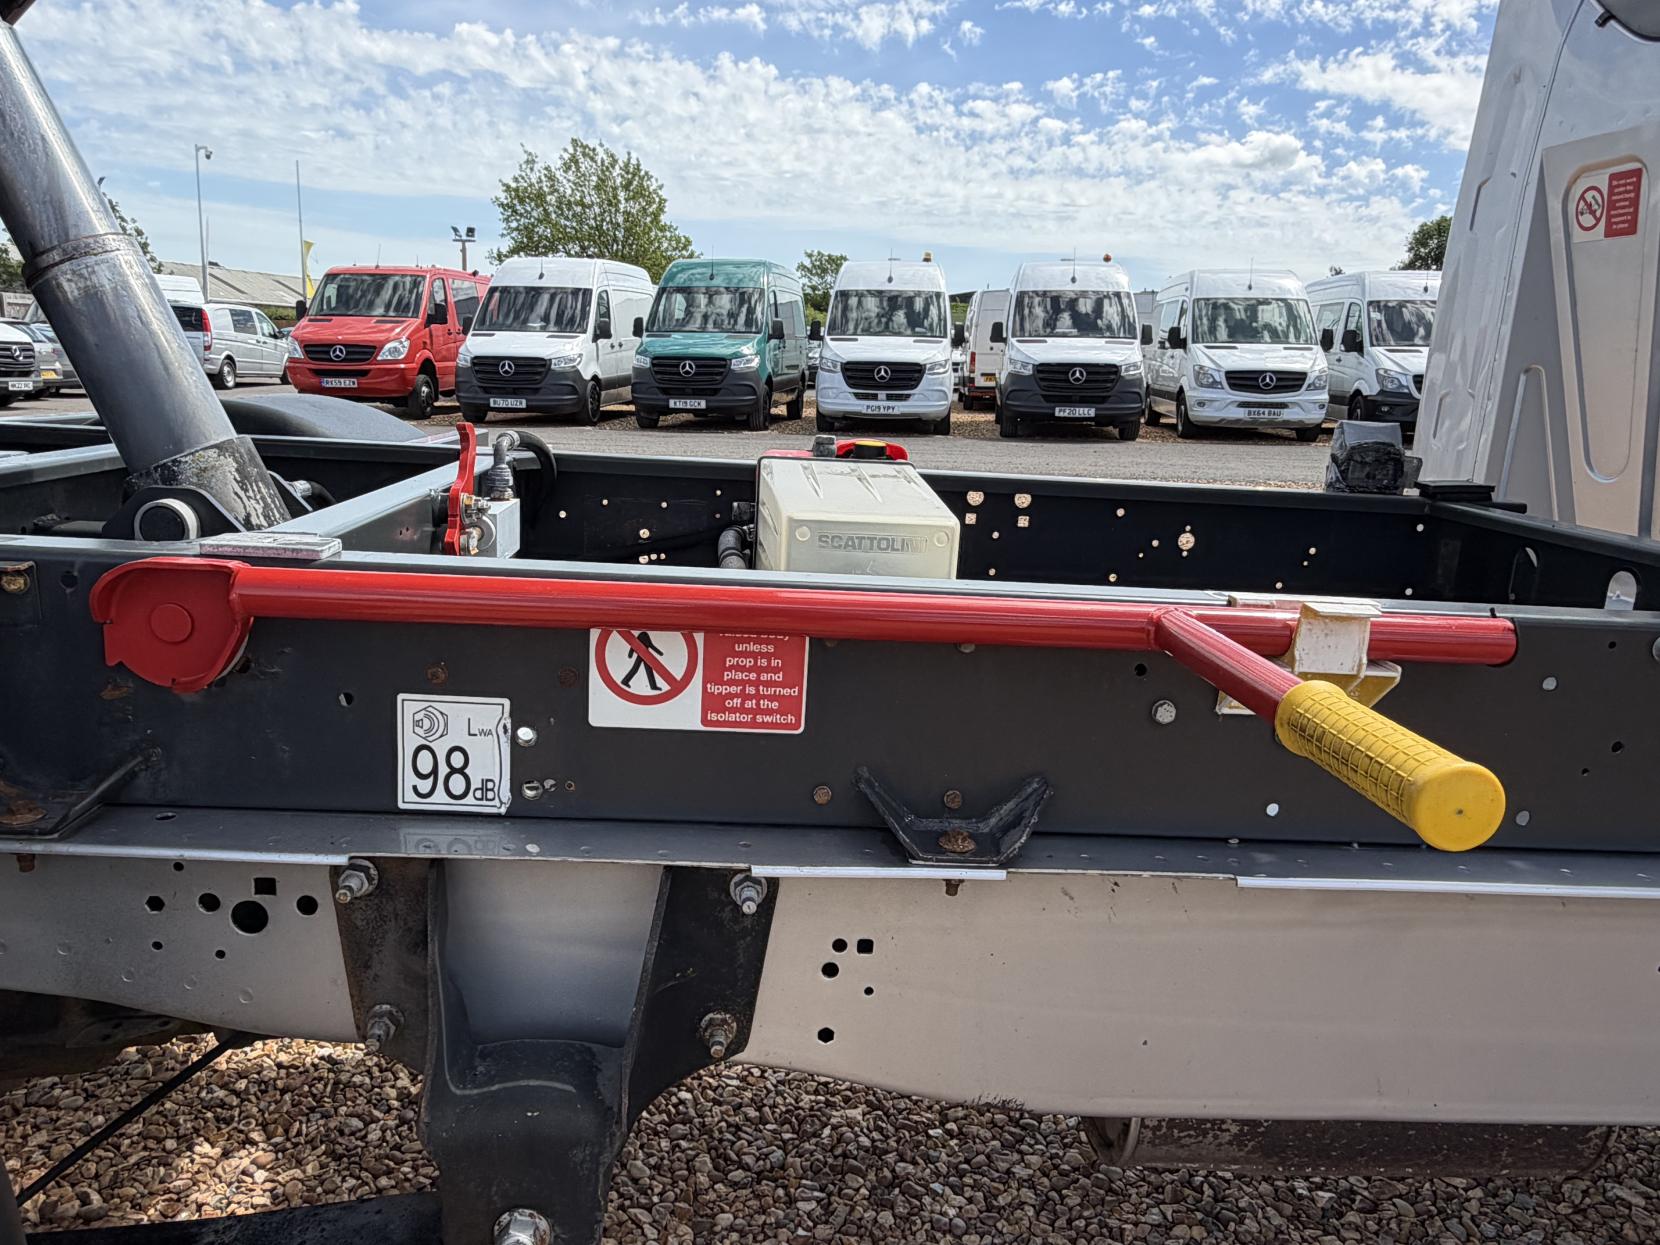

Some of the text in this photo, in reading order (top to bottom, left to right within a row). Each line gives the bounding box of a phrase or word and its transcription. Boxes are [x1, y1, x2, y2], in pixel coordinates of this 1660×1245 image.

[882, 405, 896, 413] YPY
[1058, 408, 1092, 416] PF20 LLC
[735, 642, 774, 653] unless
[726, 656, 782, 668] prop is in
[723, 670, 783, 682] place and
[706, 682, 799, 696] tipper is turned
[725, 698, 779, 709] off at the
[707, 710, 796, 724] isolator switch
[411, 744, 497, 802] 98 dB
